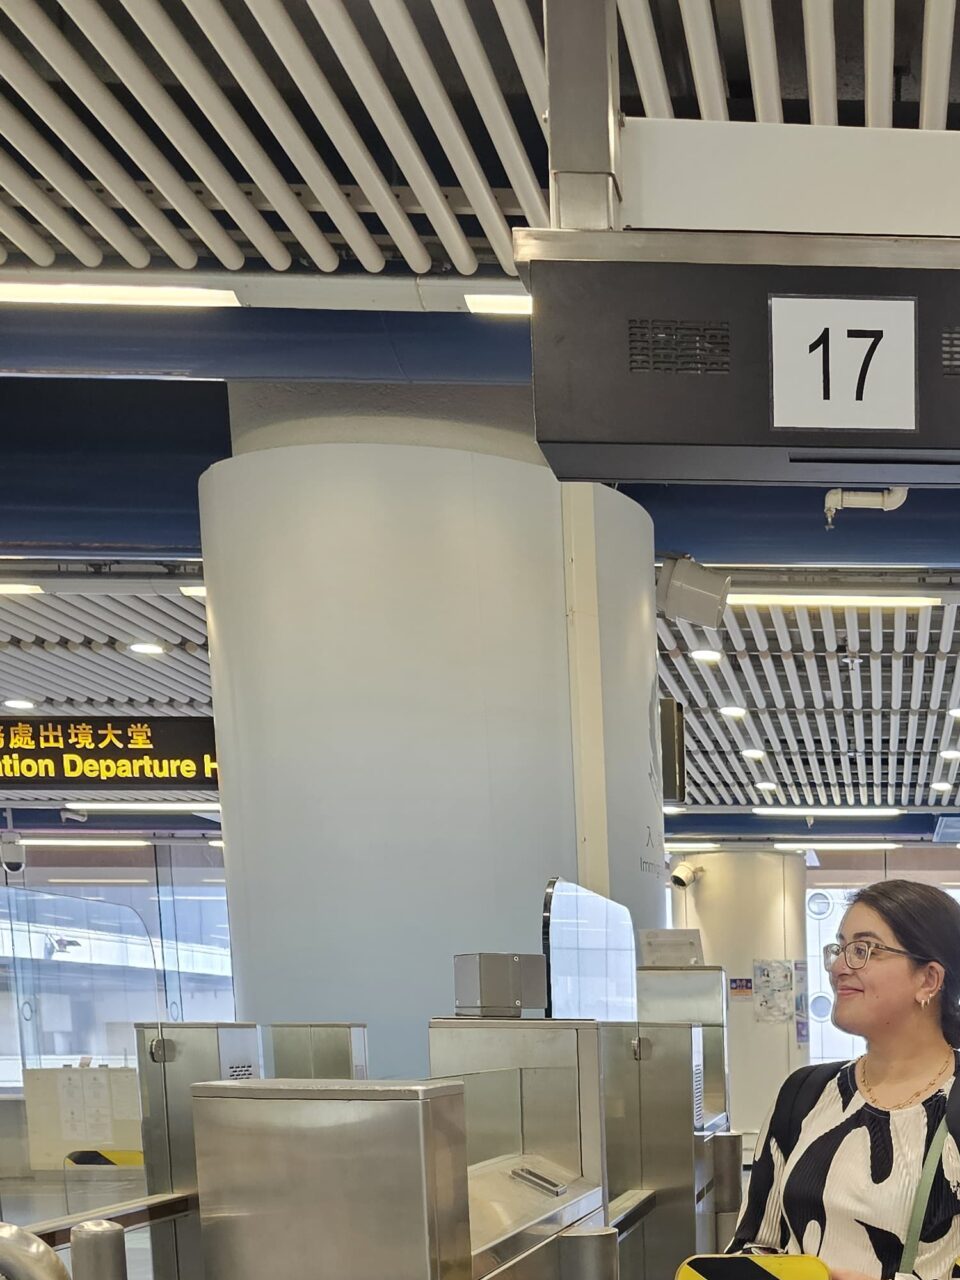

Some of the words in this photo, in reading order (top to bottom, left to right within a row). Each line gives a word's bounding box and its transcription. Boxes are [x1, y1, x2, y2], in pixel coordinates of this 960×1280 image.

[808, 327, 884, 401] 17
[0, 723, 154, 749] 處出境大堂
[0, 753, 55, 778] tion
[63, 754, 196, 780] Departure
